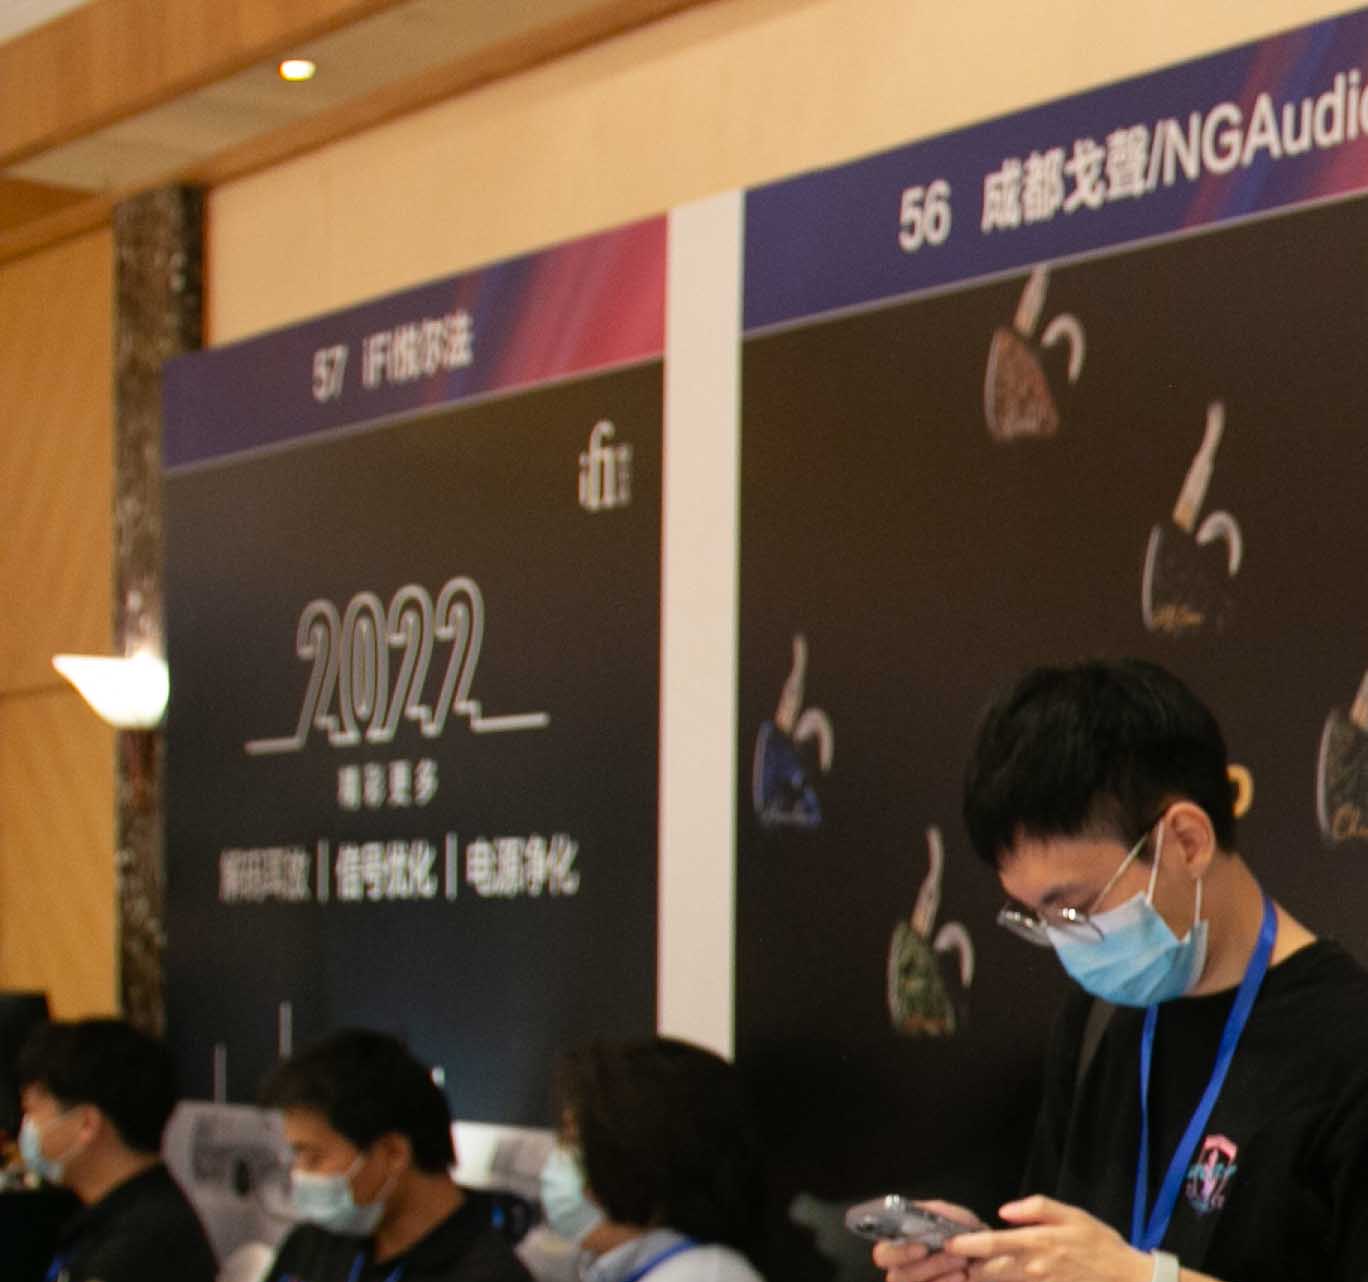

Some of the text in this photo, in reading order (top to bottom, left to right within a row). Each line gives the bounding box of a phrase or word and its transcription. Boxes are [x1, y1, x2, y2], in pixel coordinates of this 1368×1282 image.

[899, 179, 952, 253] 56
[312, 345, 348, 403] 57
[294, 574, 488, 750] 2022
[336, 840, 439, 901] 信号优化
